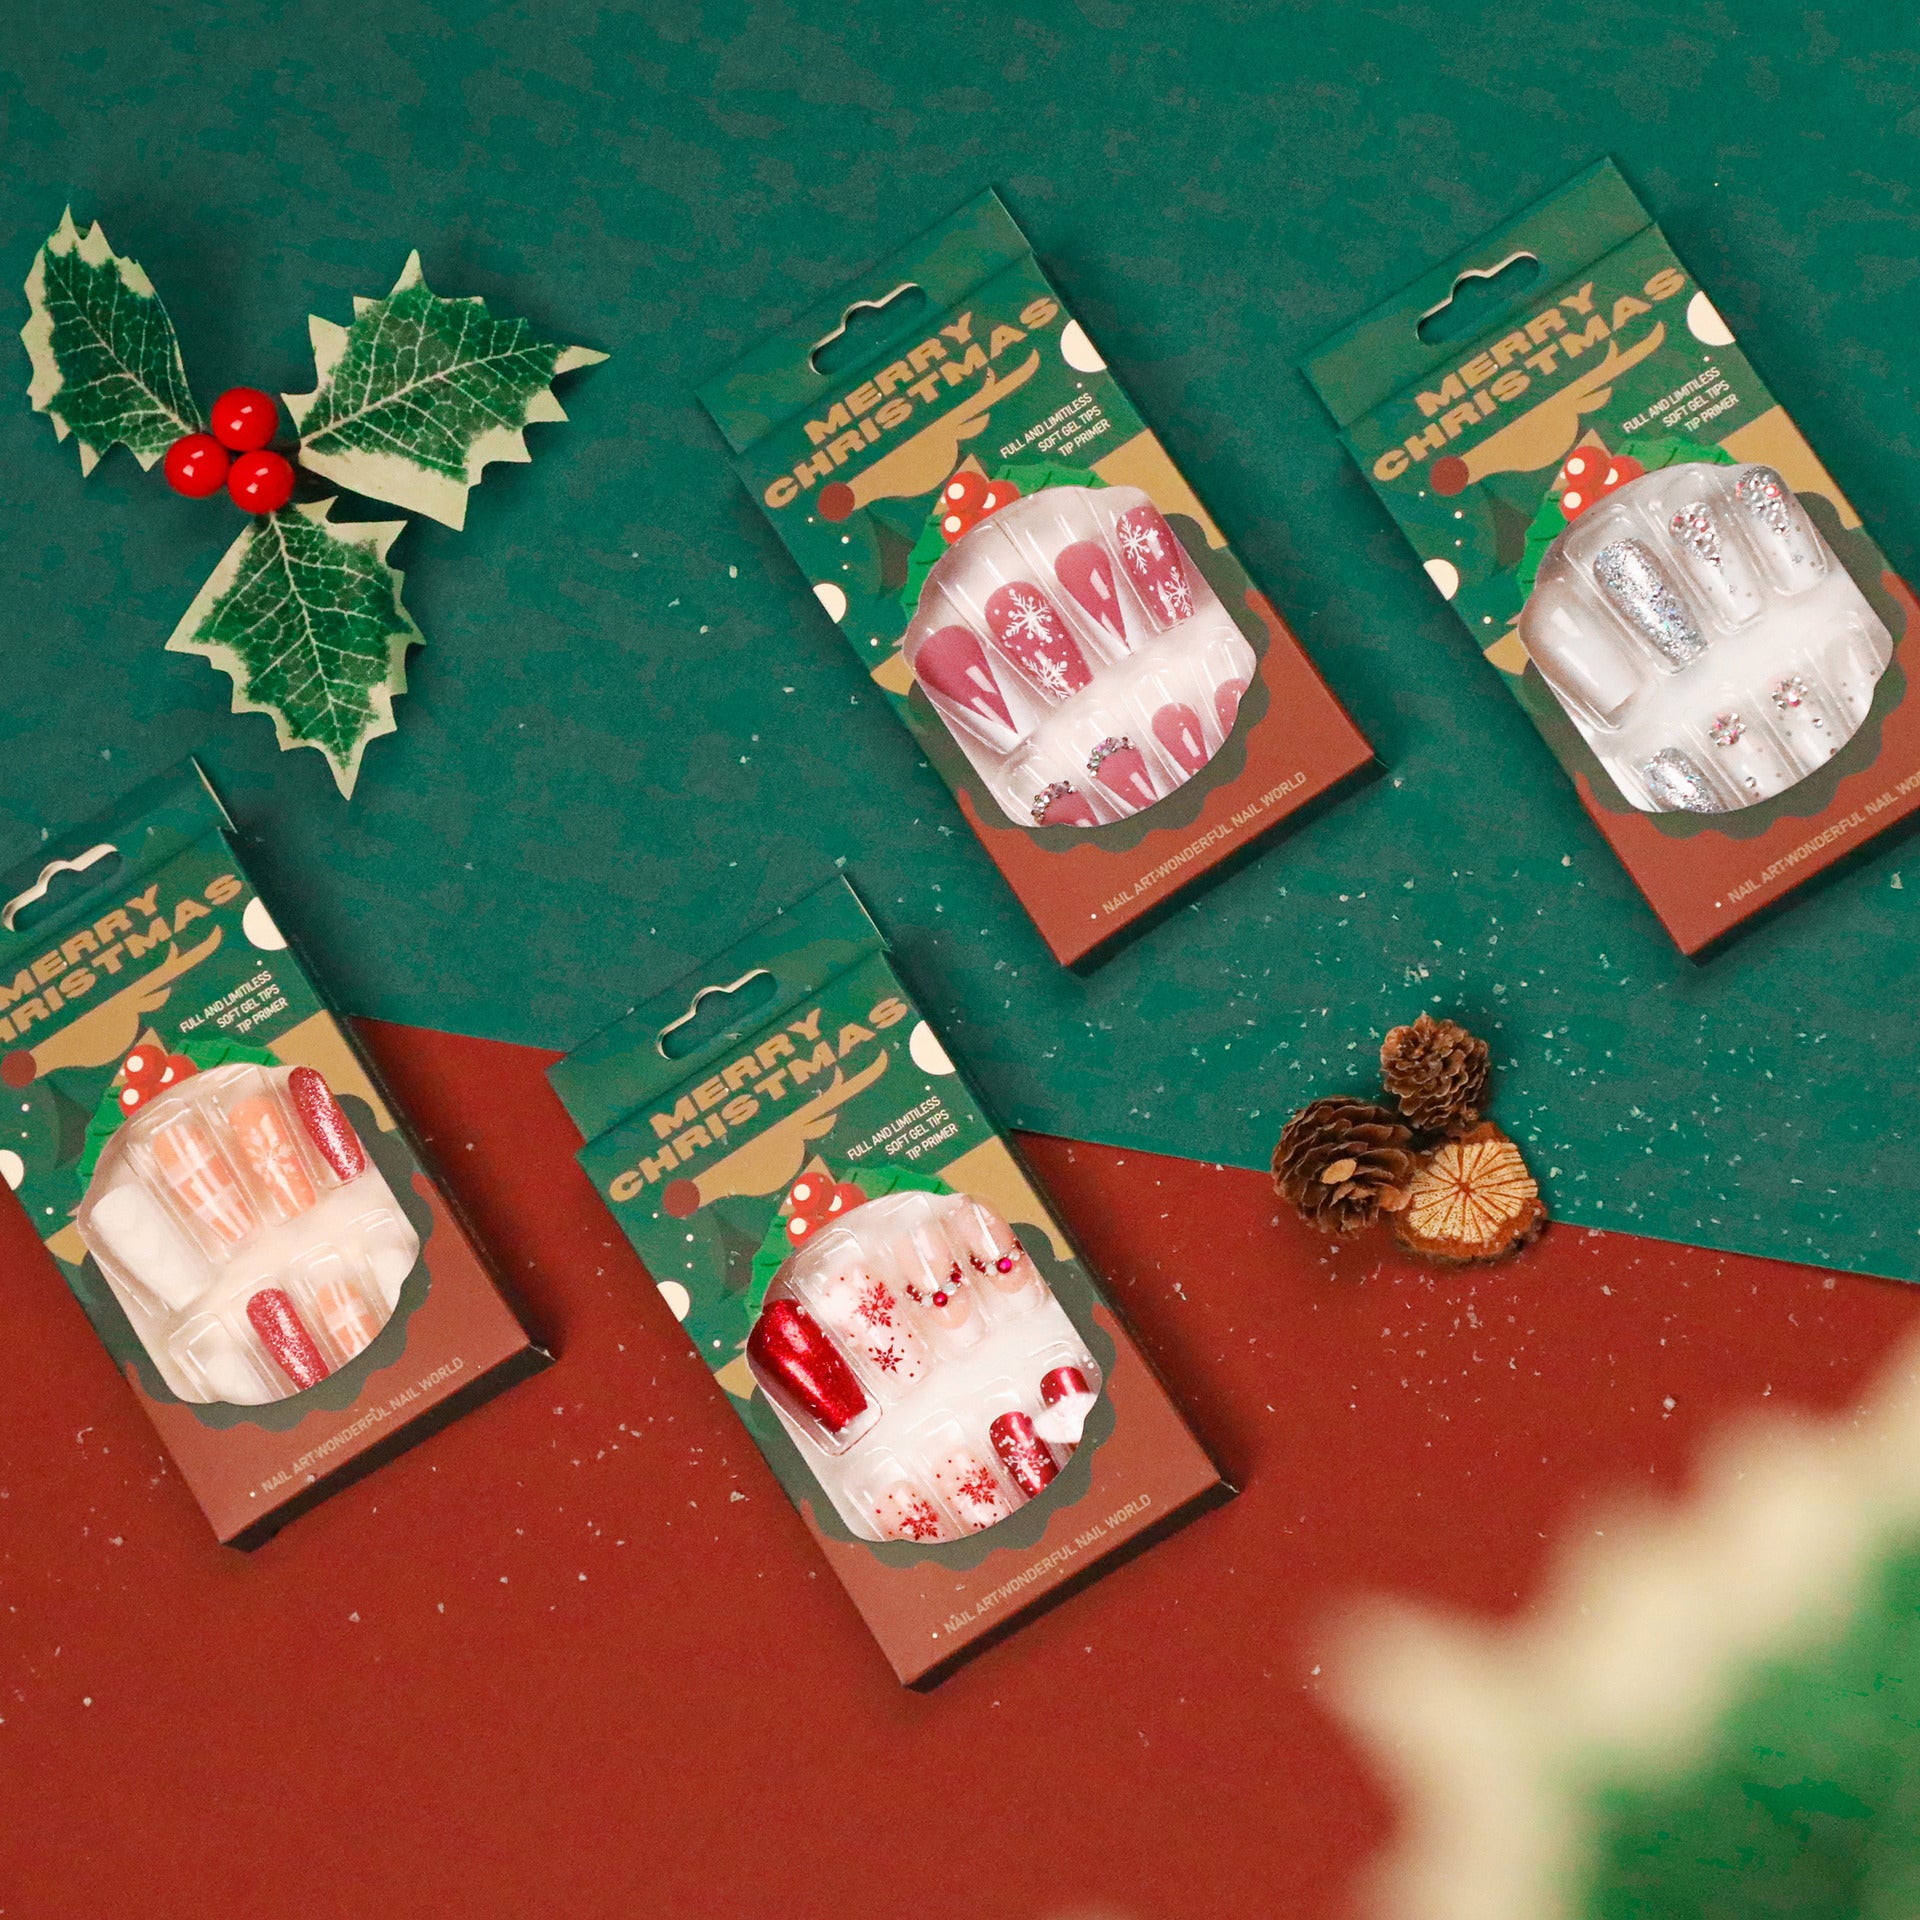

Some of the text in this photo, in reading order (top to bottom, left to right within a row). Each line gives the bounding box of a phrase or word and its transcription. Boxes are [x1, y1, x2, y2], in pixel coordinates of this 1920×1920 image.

[1414, 281, 1595, 417] MERRY
[804, 311, 973, 446] MERRY
[1373, 267, 1685, 481] CHRISTMAS
[764, 297, 1059, 509] CHRISTMAS
[1623, 413, 1649, 434] FULL
[1648, 399, 1670, 419] AND
[1662, 380, 1730, 428] SOFT GEL TIPS
[1684, 393, 1740, 432] TIP PRIMER
[1000, 439, 1026, 459] FULL
[1024, 424, 1045, 444] AND
[1038, 405, 1101, 452] SOFT GEL TIPS
[1058, 418, 1111, 457] TIP PRIMER
[1102, 891, 1134, 915] NAIL
[1230, 802, 1263, 827] NAIL
[1259, 771, 1307, 808] WORLD
[1727, 879, 1761, 903] NAIL
[1864, 792, 1899, 816] NAIL
[0, 883, 158, 1011] MERRY
[179, 1014, 206, 1033] FULL
[203, 1000, 225, 1019] AND
[216, 983, 280, 1028] SOFT GEL TIPS
[235, 997, 289, 1033] TIP PRIMER
[649, 1008, 821, 1139] MERRY
[609, 997, 908, 1202] CHRISTMAS
[847, 1141, 873, 1161] FULL
[871, 1126, 892, 1146] AND
[885, 1109, 950, 1156] SOFT GEL TIPS
[905, 1123, 959, 1161] TIP PRIMER
[261, 1470, 293, 1493] NAIL
[389, 1387, 421, 1411] NAIL
[417, 1357, 464, 1392] WORLD
[943, 1611, 976, 1635] NAIL
[1075, 1524, 1107, 1548] NAIL
[1104, 1493, 1153, 1530] WORLD
